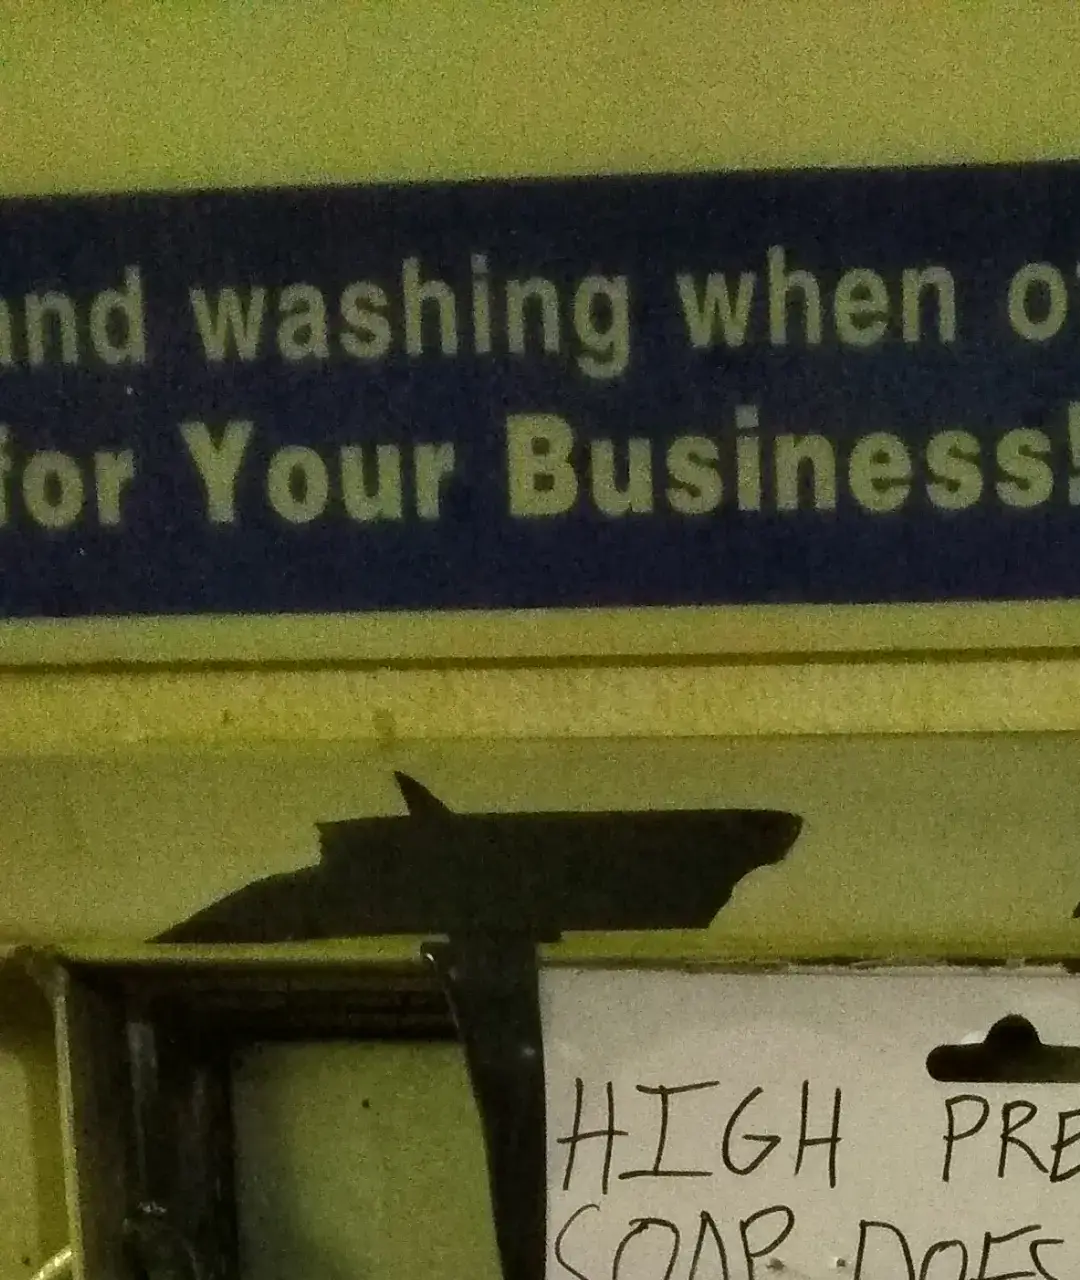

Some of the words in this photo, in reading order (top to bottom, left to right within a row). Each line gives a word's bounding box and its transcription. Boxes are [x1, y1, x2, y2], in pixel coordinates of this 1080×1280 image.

[0, 264, 146, 367] nd
[189, 252, 632, 379] washing
[677, 243, 959, 350] when
[180, 419, 456, 526] Your
[556, 1077, 842, 1194] HIGH
